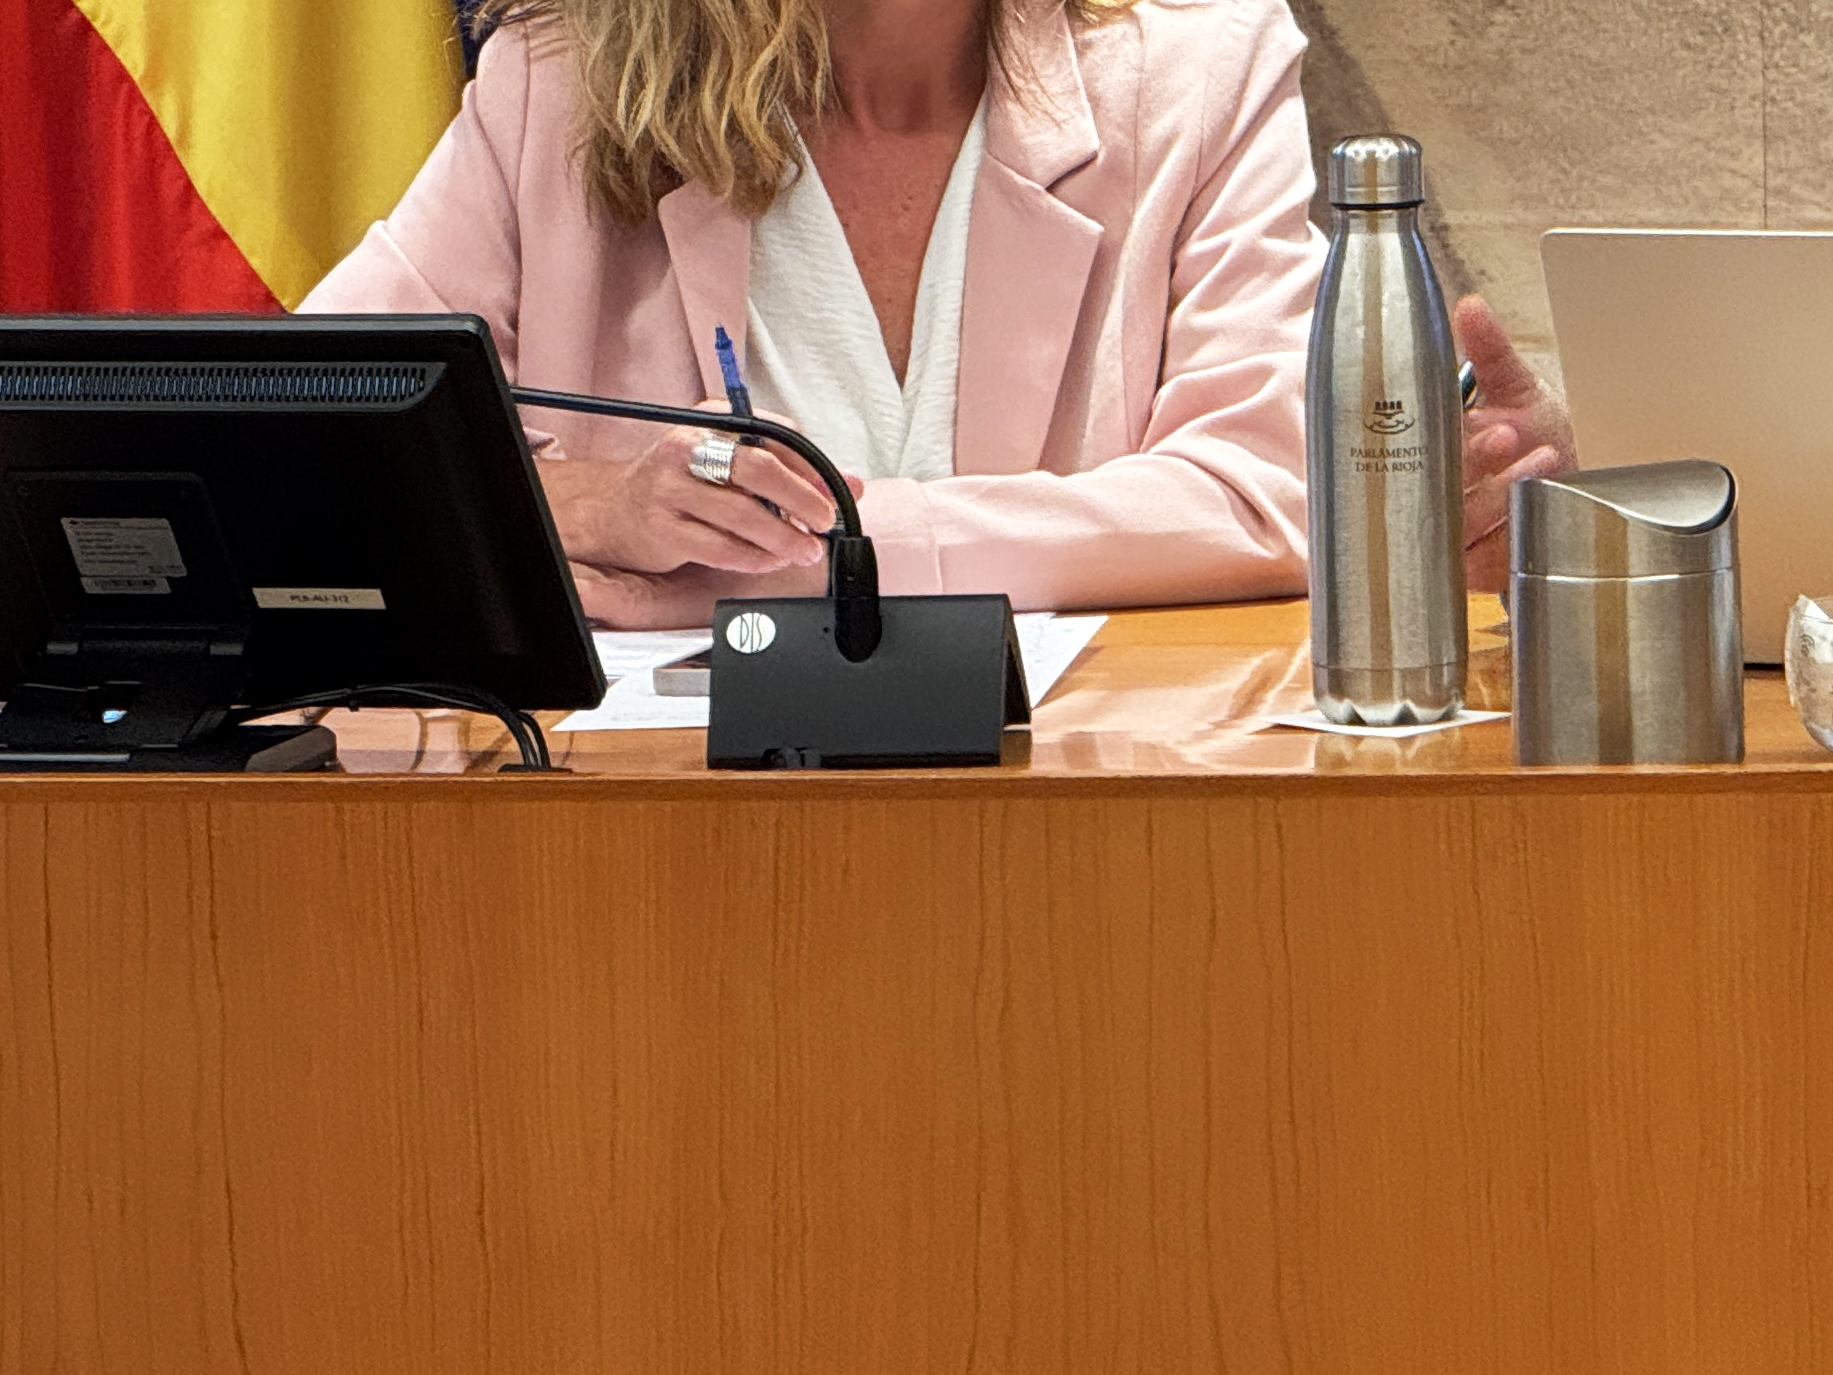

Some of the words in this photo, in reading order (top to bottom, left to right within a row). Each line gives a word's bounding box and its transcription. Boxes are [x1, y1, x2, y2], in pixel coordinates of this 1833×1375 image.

[1350, 446, 1429, 459] PARLAMENTO
[1355, 461, 1372, 472] DE
[1375, 461, 1390, 473] LA
[1392, 460, 1425, 473] RIOJA
